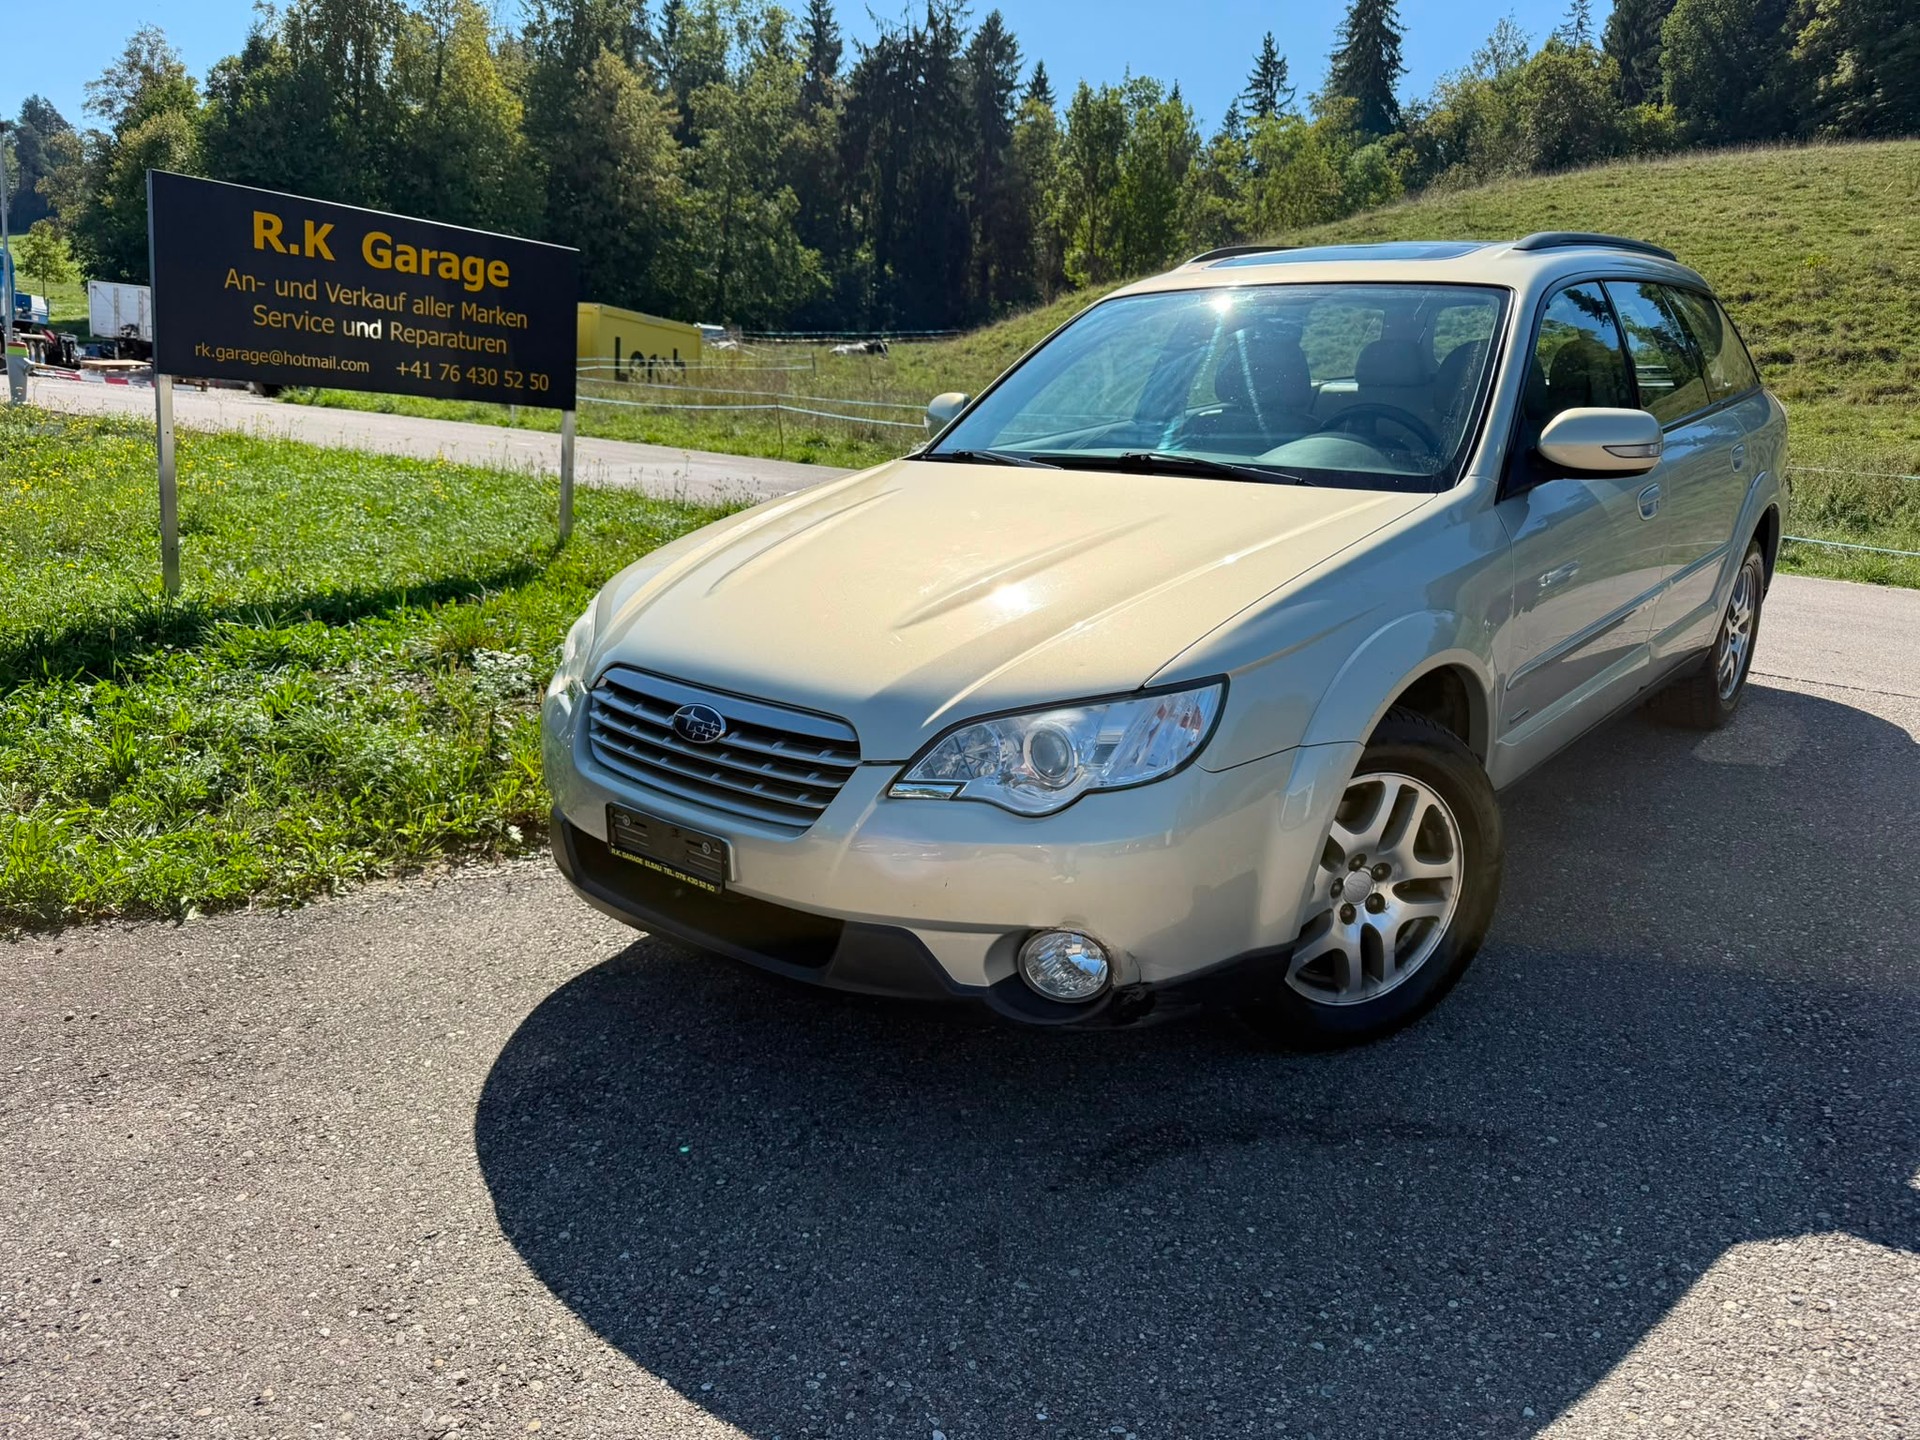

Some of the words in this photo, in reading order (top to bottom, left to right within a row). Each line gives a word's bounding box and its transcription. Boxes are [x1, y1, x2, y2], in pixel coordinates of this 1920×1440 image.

[254, 211, 335, 260] R.K
[362, 231, 510, 292] Garage
[225, 269, 265, 292] An-
[276, 280, 316, 300] und
[326, 282, 406, 311] Verkauf
[413, 296, 454, 317] aller
[462, 302, 527, 328] Marken
[254, 305, 334, 333] Service
[343, 319, 382, 339] und
[391, 322, 506, 353] Reparaturen
[196, 343, 369, 372] rk.garage@hotmail.com
[397, 361, 431, 379] +41
[440, 364, 460, 381] 76
[467, 368, 497, 385] 430
[505, 371, 522, 388] 52
[531, 374, 548, 390] 50
